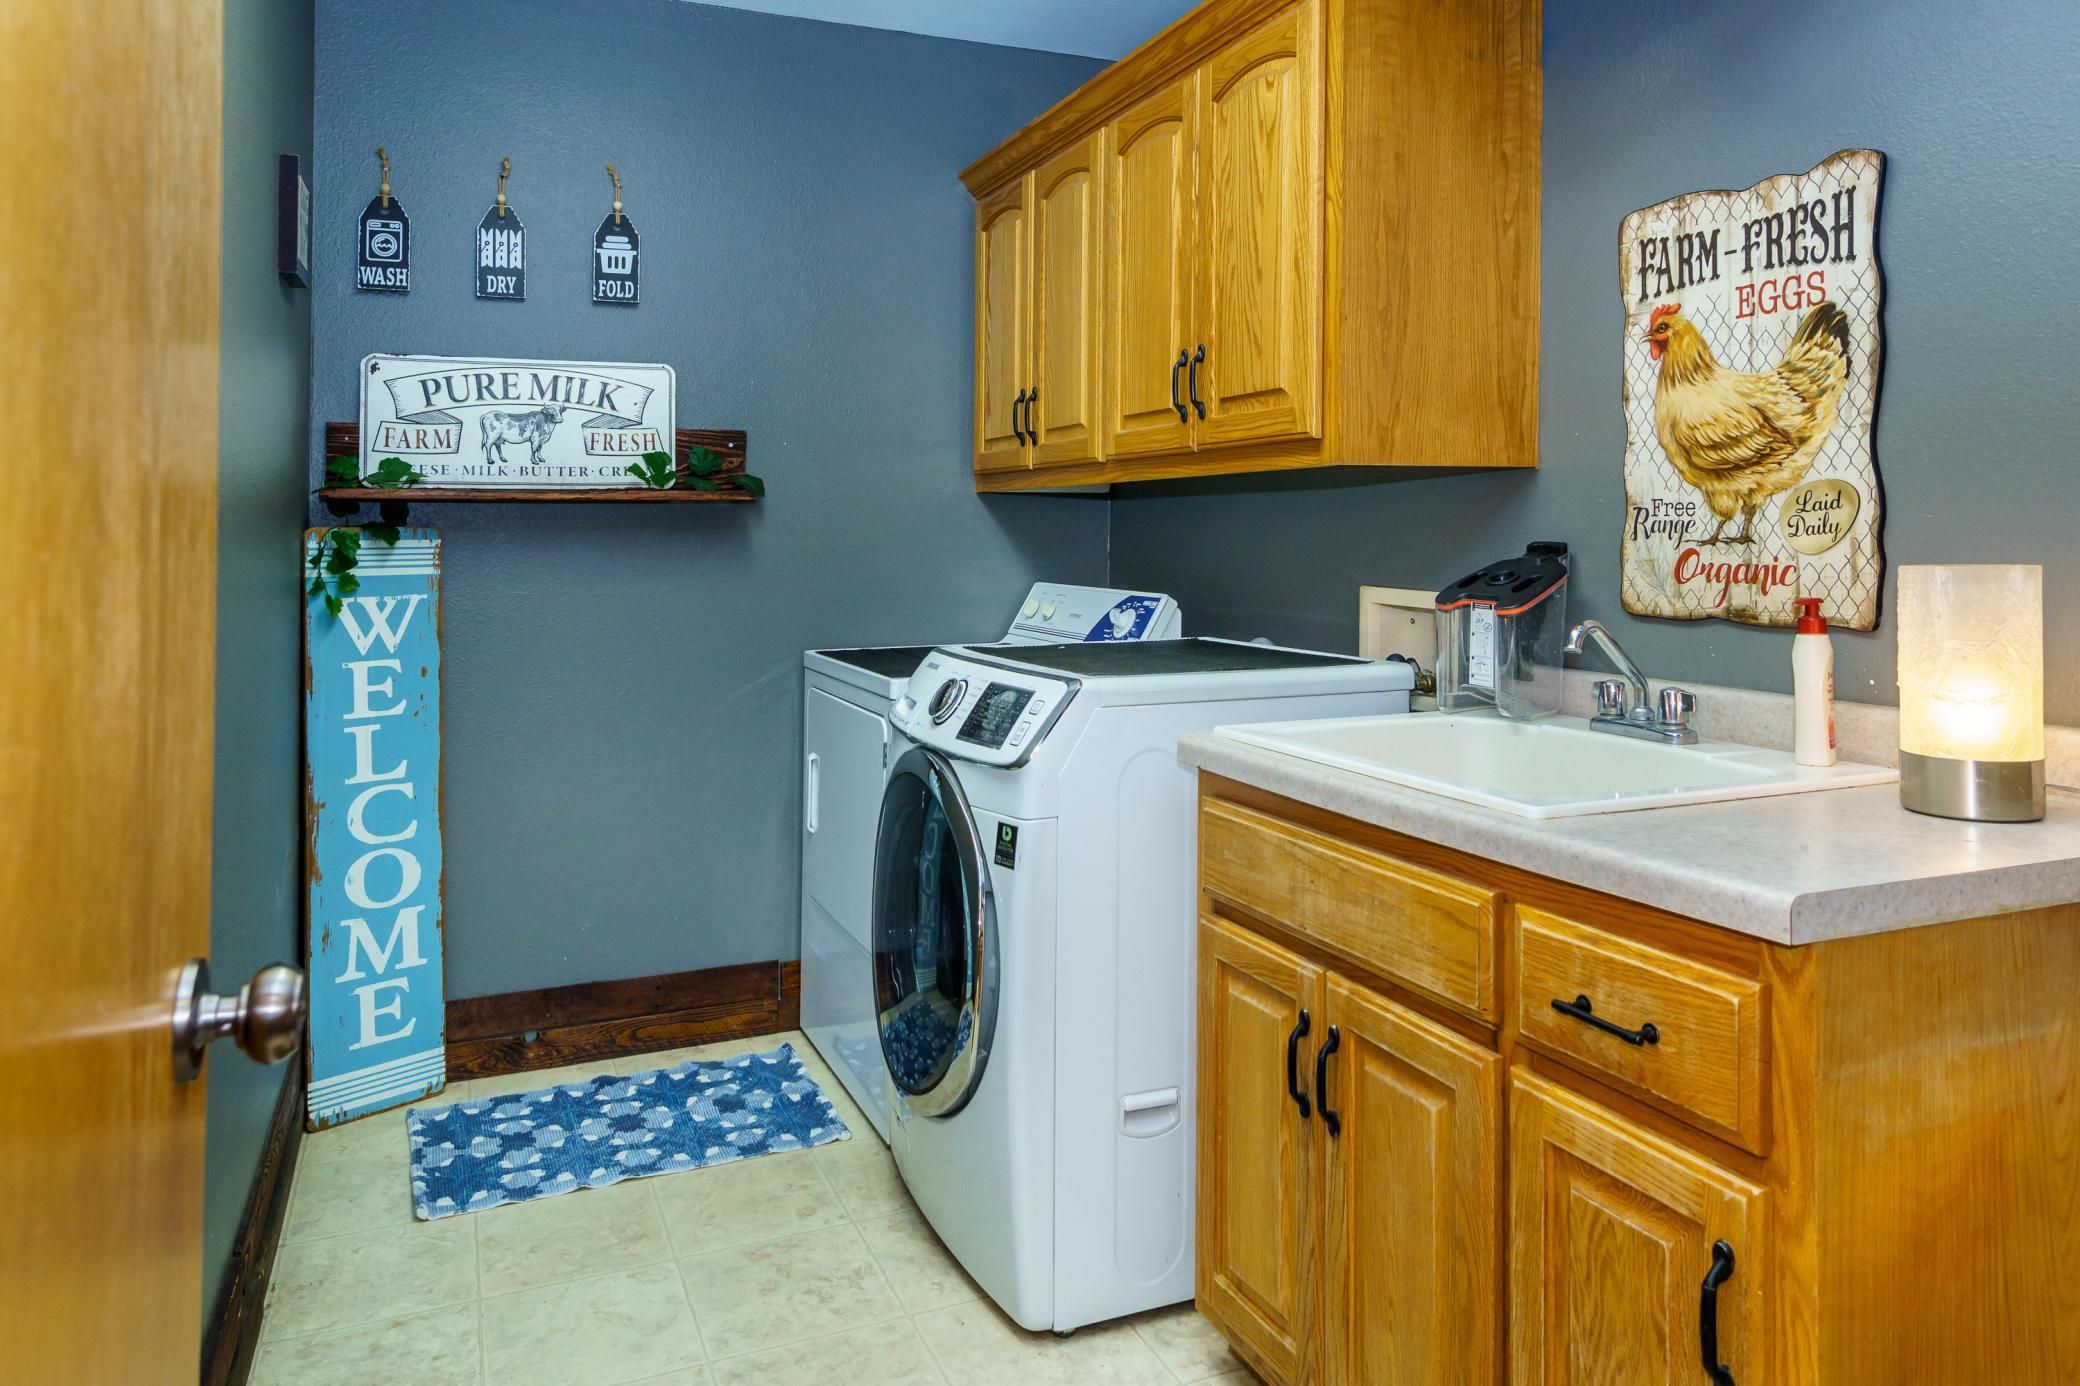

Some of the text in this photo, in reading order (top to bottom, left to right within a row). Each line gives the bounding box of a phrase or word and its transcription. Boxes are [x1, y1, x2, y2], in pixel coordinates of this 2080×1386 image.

[361, 266, 408, 287] WASH
[486, 275, 517, 295] DRY
[598, 279, 634, 299] FOLD
[1735, 270, 1827, 320] EGGS
[418, 372, 625, 413] PURE MILK
[383, 426, 453, 449] FARM
[590, 431, 657, 452] FRESH
[462, 464, 508, 477] MILK
[519, 465, 589, 478] BUTTER
[1651, 498, 1696, 517] Free
[1795, 489, 1843, 514] Laid
[1629, 506, 1700, 550] Range
[1787, 511, 1842, 542] Daily
[1673, 547, 1799, 608] Organic
[334, 594, 428, 1051] WELCOME
